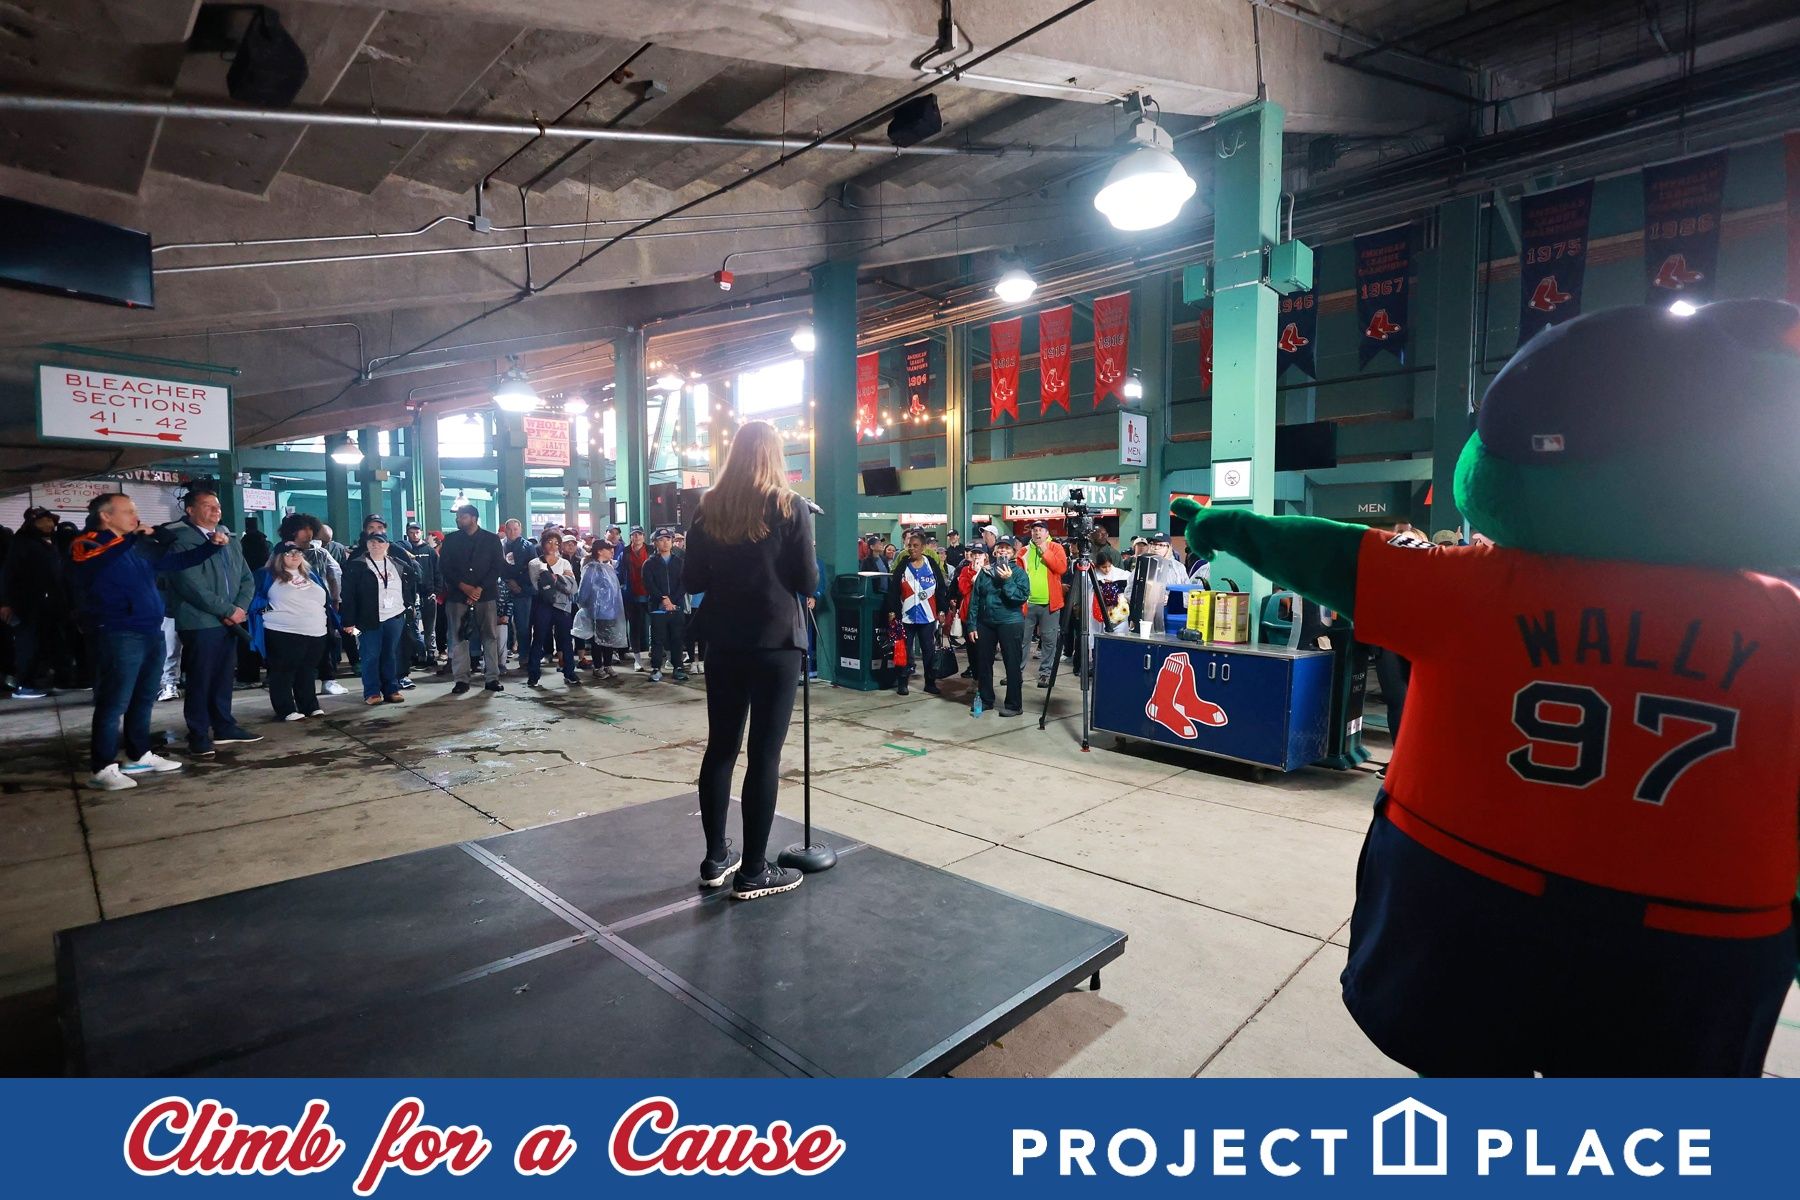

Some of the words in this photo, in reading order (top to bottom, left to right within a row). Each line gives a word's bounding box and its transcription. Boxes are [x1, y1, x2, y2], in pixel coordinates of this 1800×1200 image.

[1648, 213, 1713, 240] 1986
[1526, 238, 1582, 264] 1975
[1361, 277, 1403, 300] 1967
[66, 374, 206, 400] BLEACHER
[909, 374, 927, 387] 1904
[72, 390, 202, 415] SECTIONS
[89, 411, 116, 424] 41
[155, 417, 188, 430] 42
[526, 419, 567, 430] WHOLE
[526, 428, 567, 439] PIZZA
[527, 448, 568, 459] PIZZA
[1127, 447, 1141, 456] MEN
[46, 489, 105, 497] SECTION
[1012, 482, 1058, 502] BEER
[1009, 508, 1050, 516] PEANUTS
[1358, 503, 1386, 513] MEN
[1516, 607, 1759, 691] WALLY
[1507, 680, 1739, 806] 97
